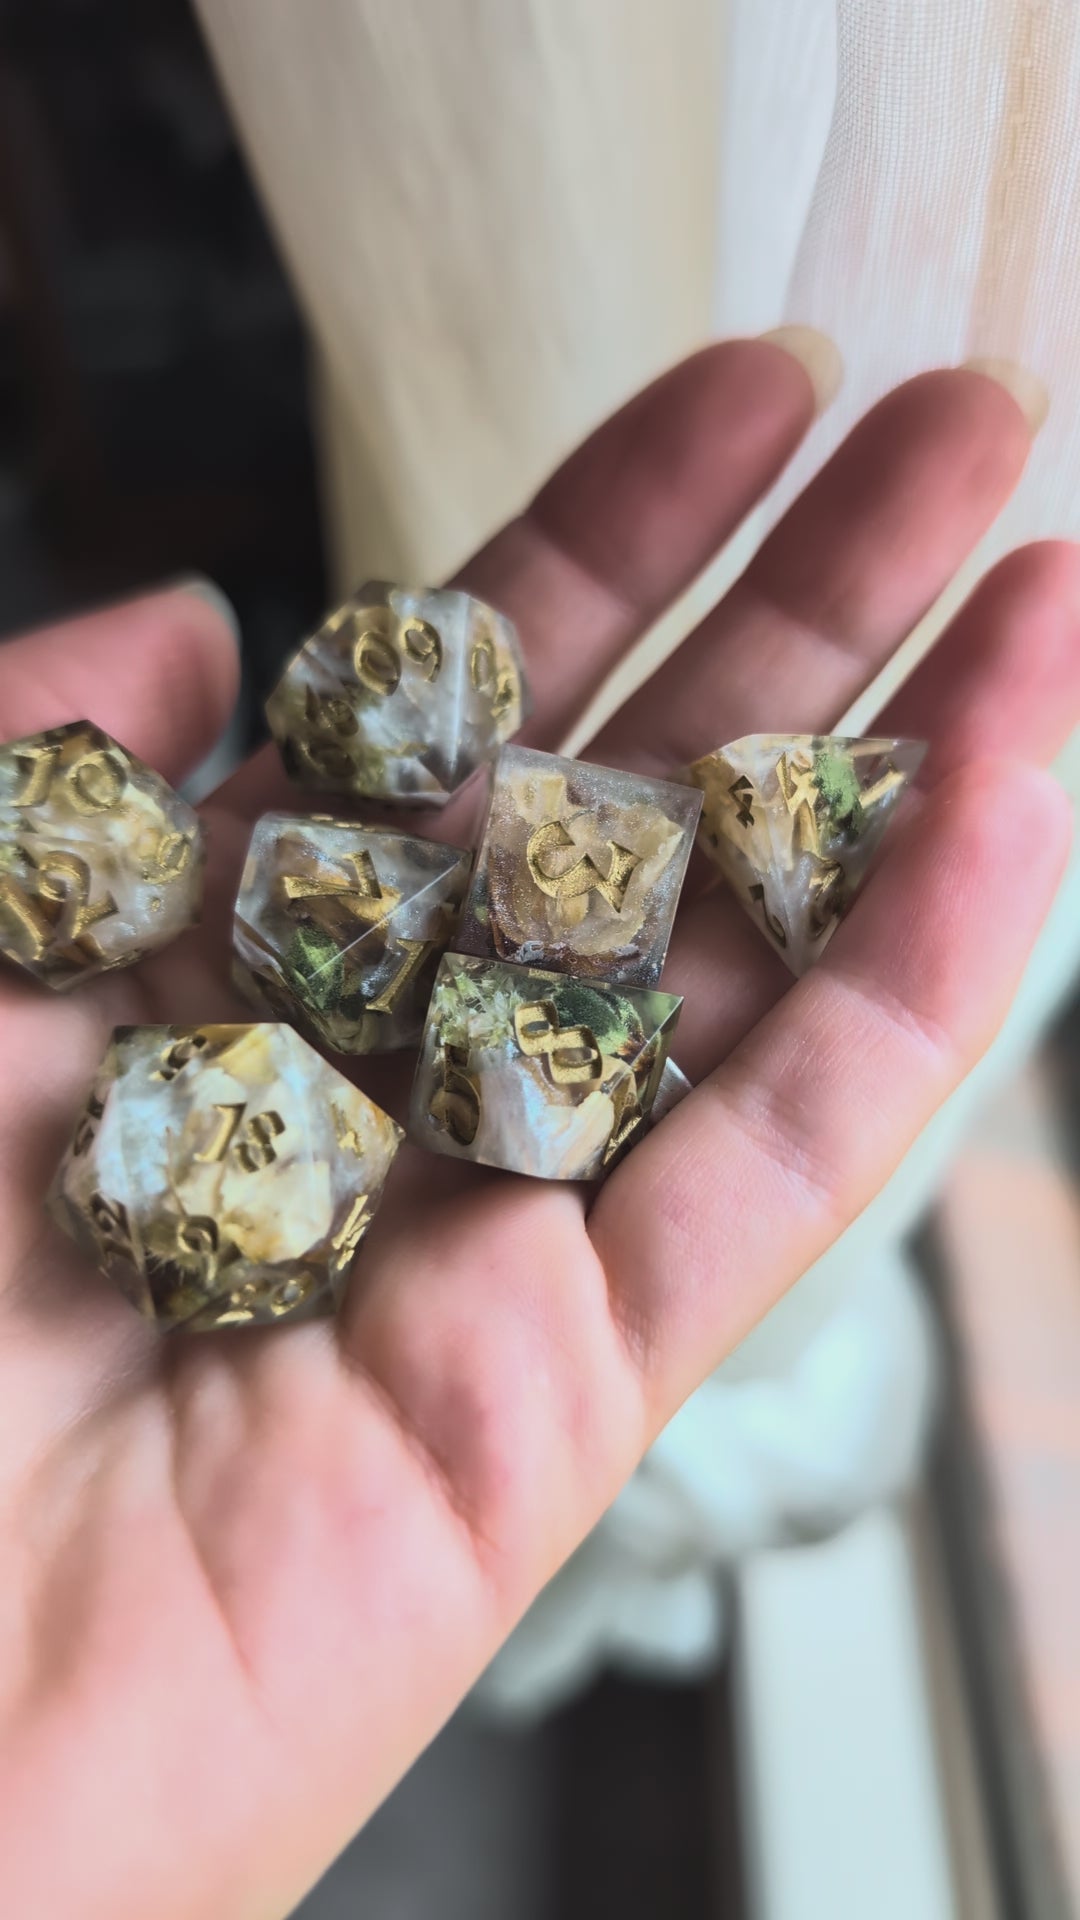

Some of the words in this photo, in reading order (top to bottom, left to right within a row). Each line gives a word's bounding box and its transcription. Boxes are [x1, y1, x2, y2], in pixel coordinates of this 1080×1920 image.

[8, 744, 128, 817] 10
[515, 1000, 603, 1085] 8
[194, 1103, 287, 1173] 18
